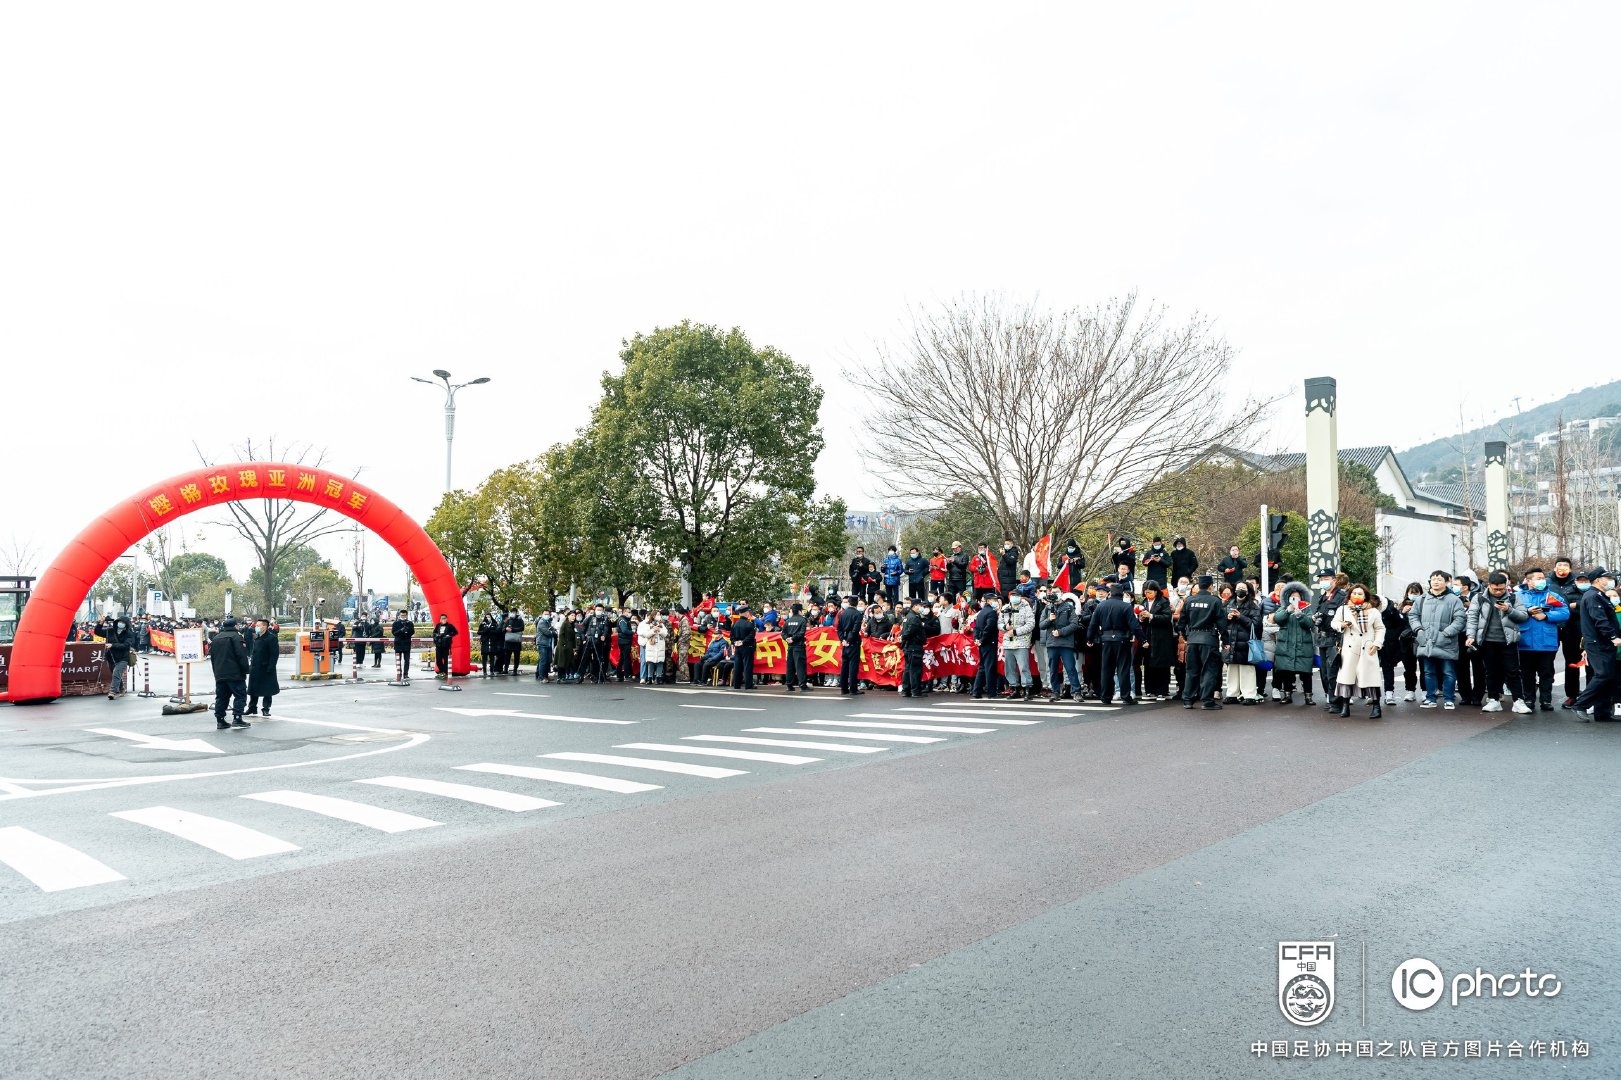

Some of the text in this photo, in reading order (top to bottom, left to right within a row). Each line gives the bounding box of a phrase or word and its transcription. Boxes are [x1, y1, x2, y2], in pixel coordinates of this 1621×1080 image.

[148, 469, 368, 517] 铿锵玫瑰亚洲冠军
